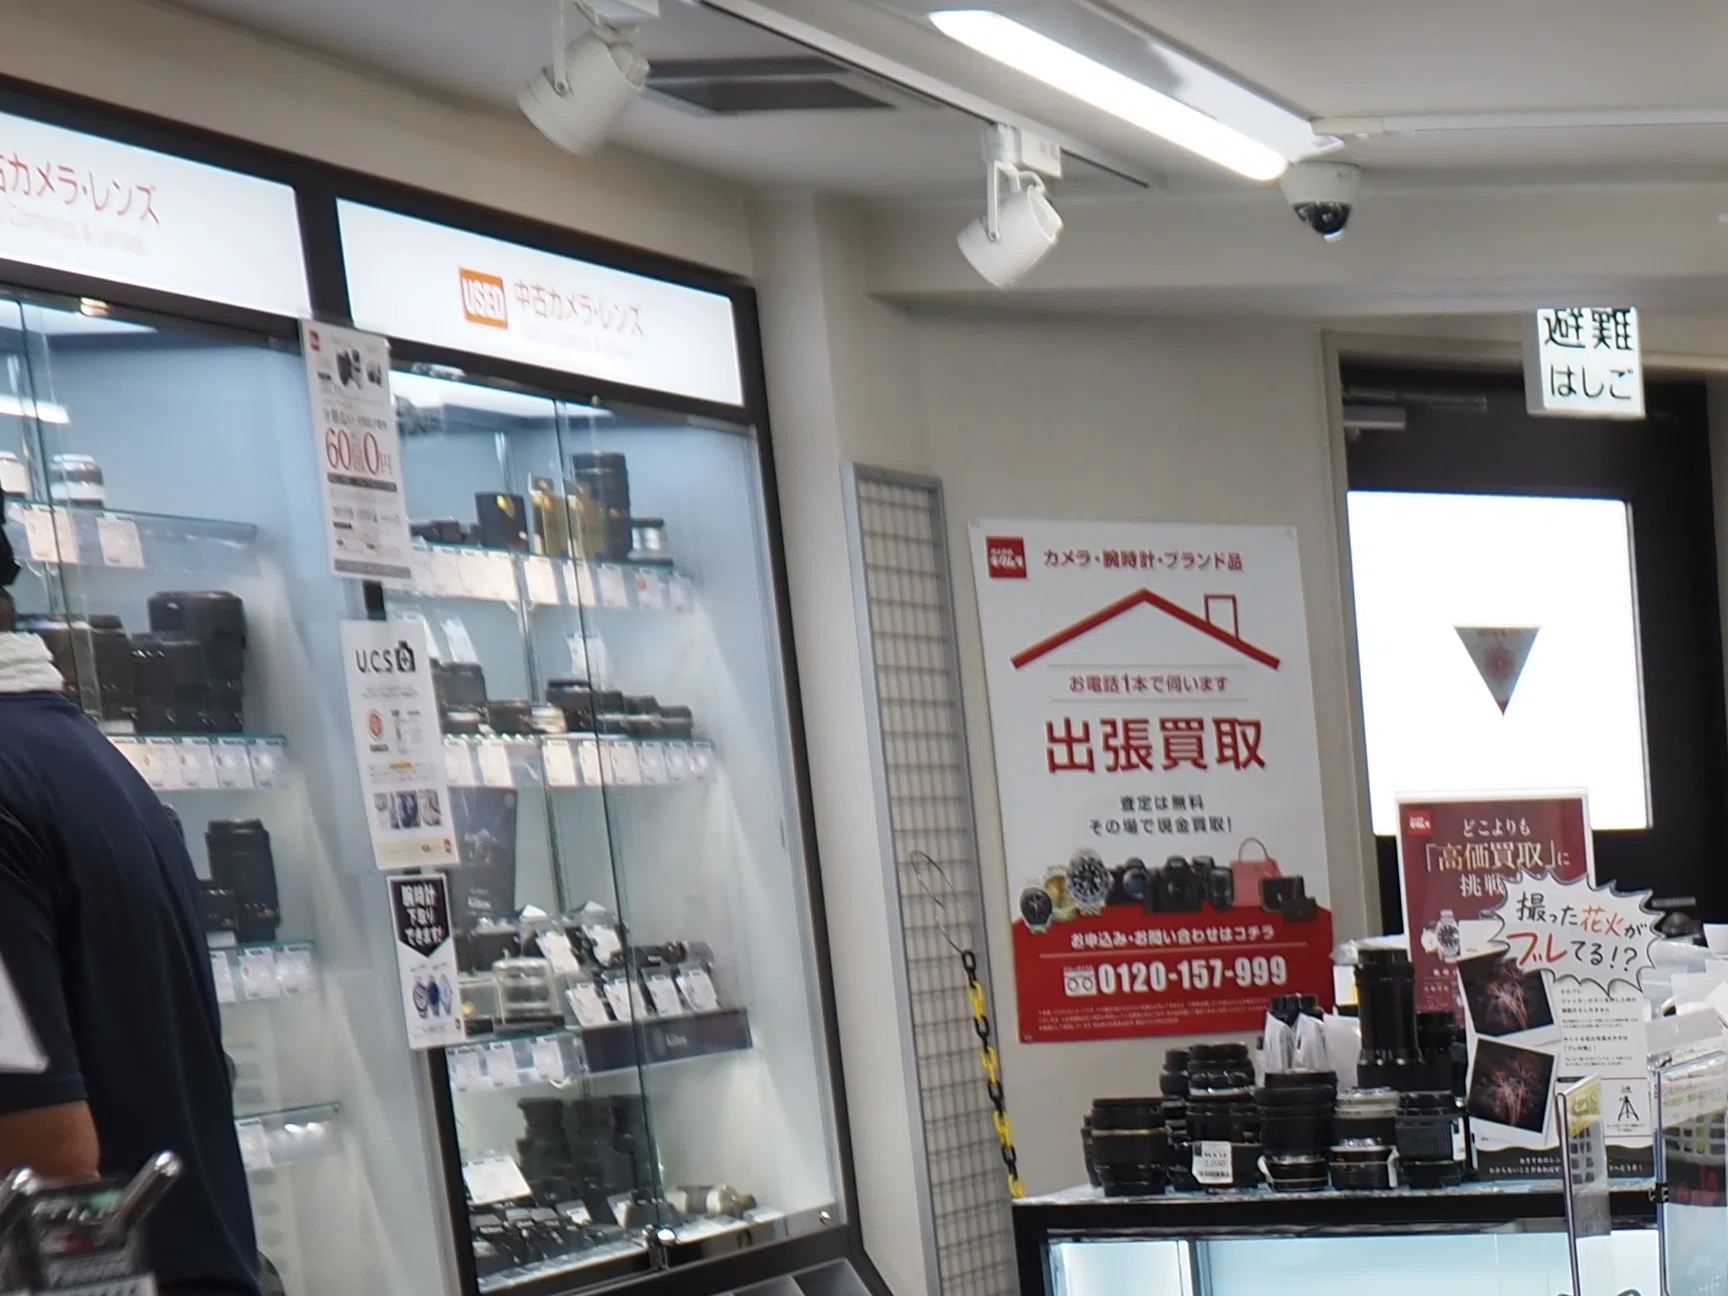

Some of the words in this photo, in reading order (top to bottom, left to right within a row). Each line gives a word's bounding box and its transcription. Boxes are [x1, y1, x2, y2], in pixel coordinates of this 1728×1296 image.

[0, 152, 159, 224] カメラ・レンズ
[462, 277, 506, 320] USED
[514, 276, 644, 336] 中古カメラ・レンズ
[1543, 308, 1634, 351] 避難
[1550, 364, 1634, 400] はしご
[1044, 548, 1243, 572] カメラ・腕時計・ブランド品
[1069, 674, 1230, 693] お電話1本で伺います
[1046, 717, 1266, 774] 出張買取
[1121, 794, 1204, 812] 査定は無料
[1462, 817, 1531, 837] どこよりも
[1425, 840, 1571, 873] 「高価買取」に
[1516, 892, 1649, 940] 撮った花火が
[1098, 955, 1287, 995] 0120-157-999
